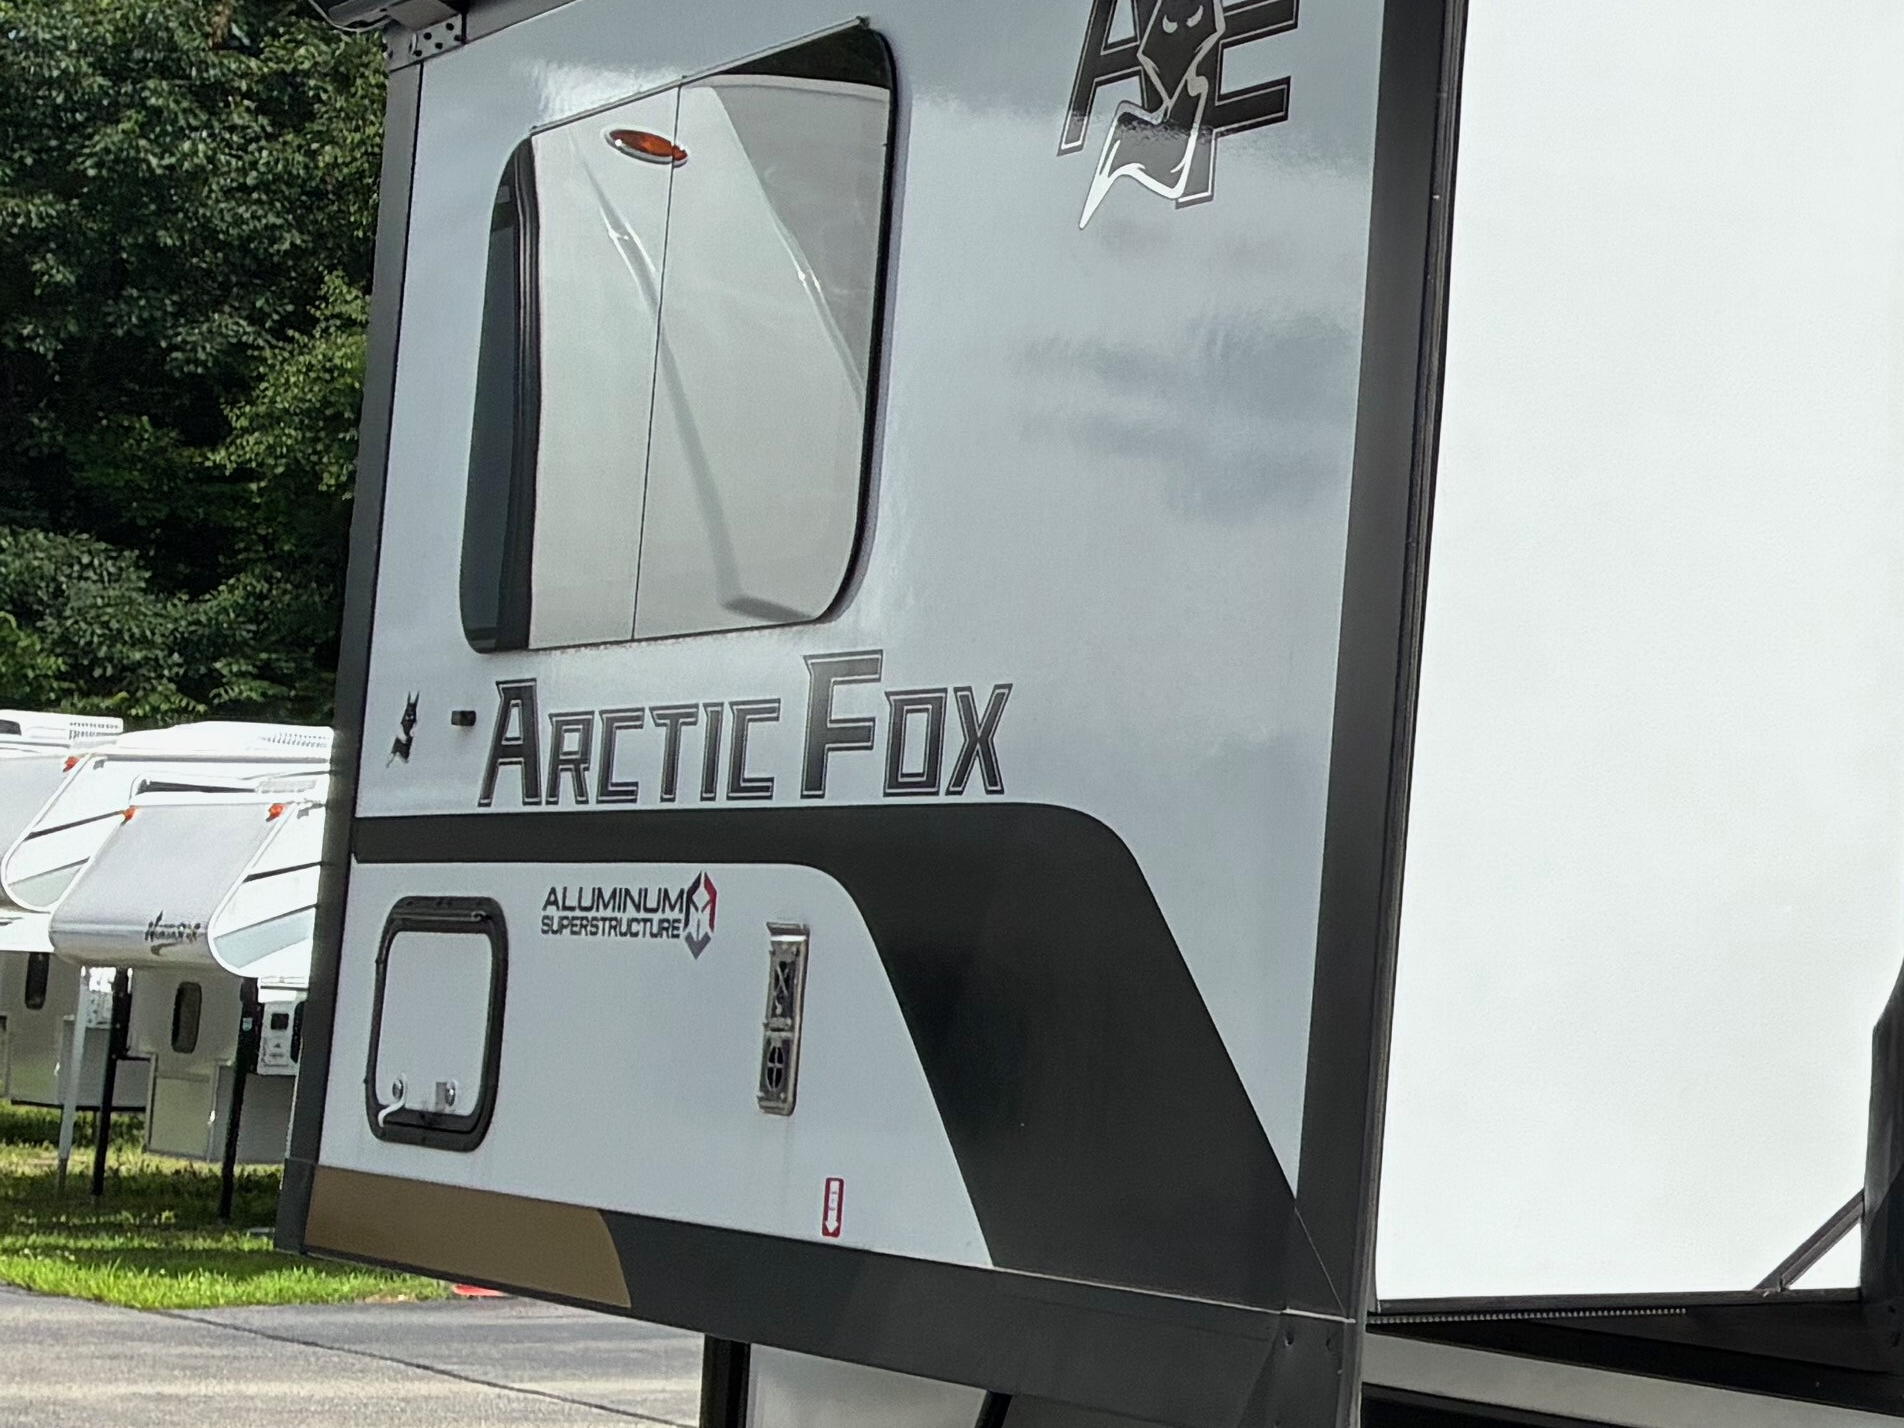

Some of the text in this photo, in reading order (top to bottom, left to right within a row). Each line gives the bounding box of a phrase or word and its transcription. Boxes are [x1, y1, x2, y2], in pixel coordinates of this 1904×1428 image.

[476, 649, 1014, 808] ARCTIC FOX
[541, 885, 686, 915] ALUMINUM
[540, 914, 683, 940] SUPERSTRUCTURE
